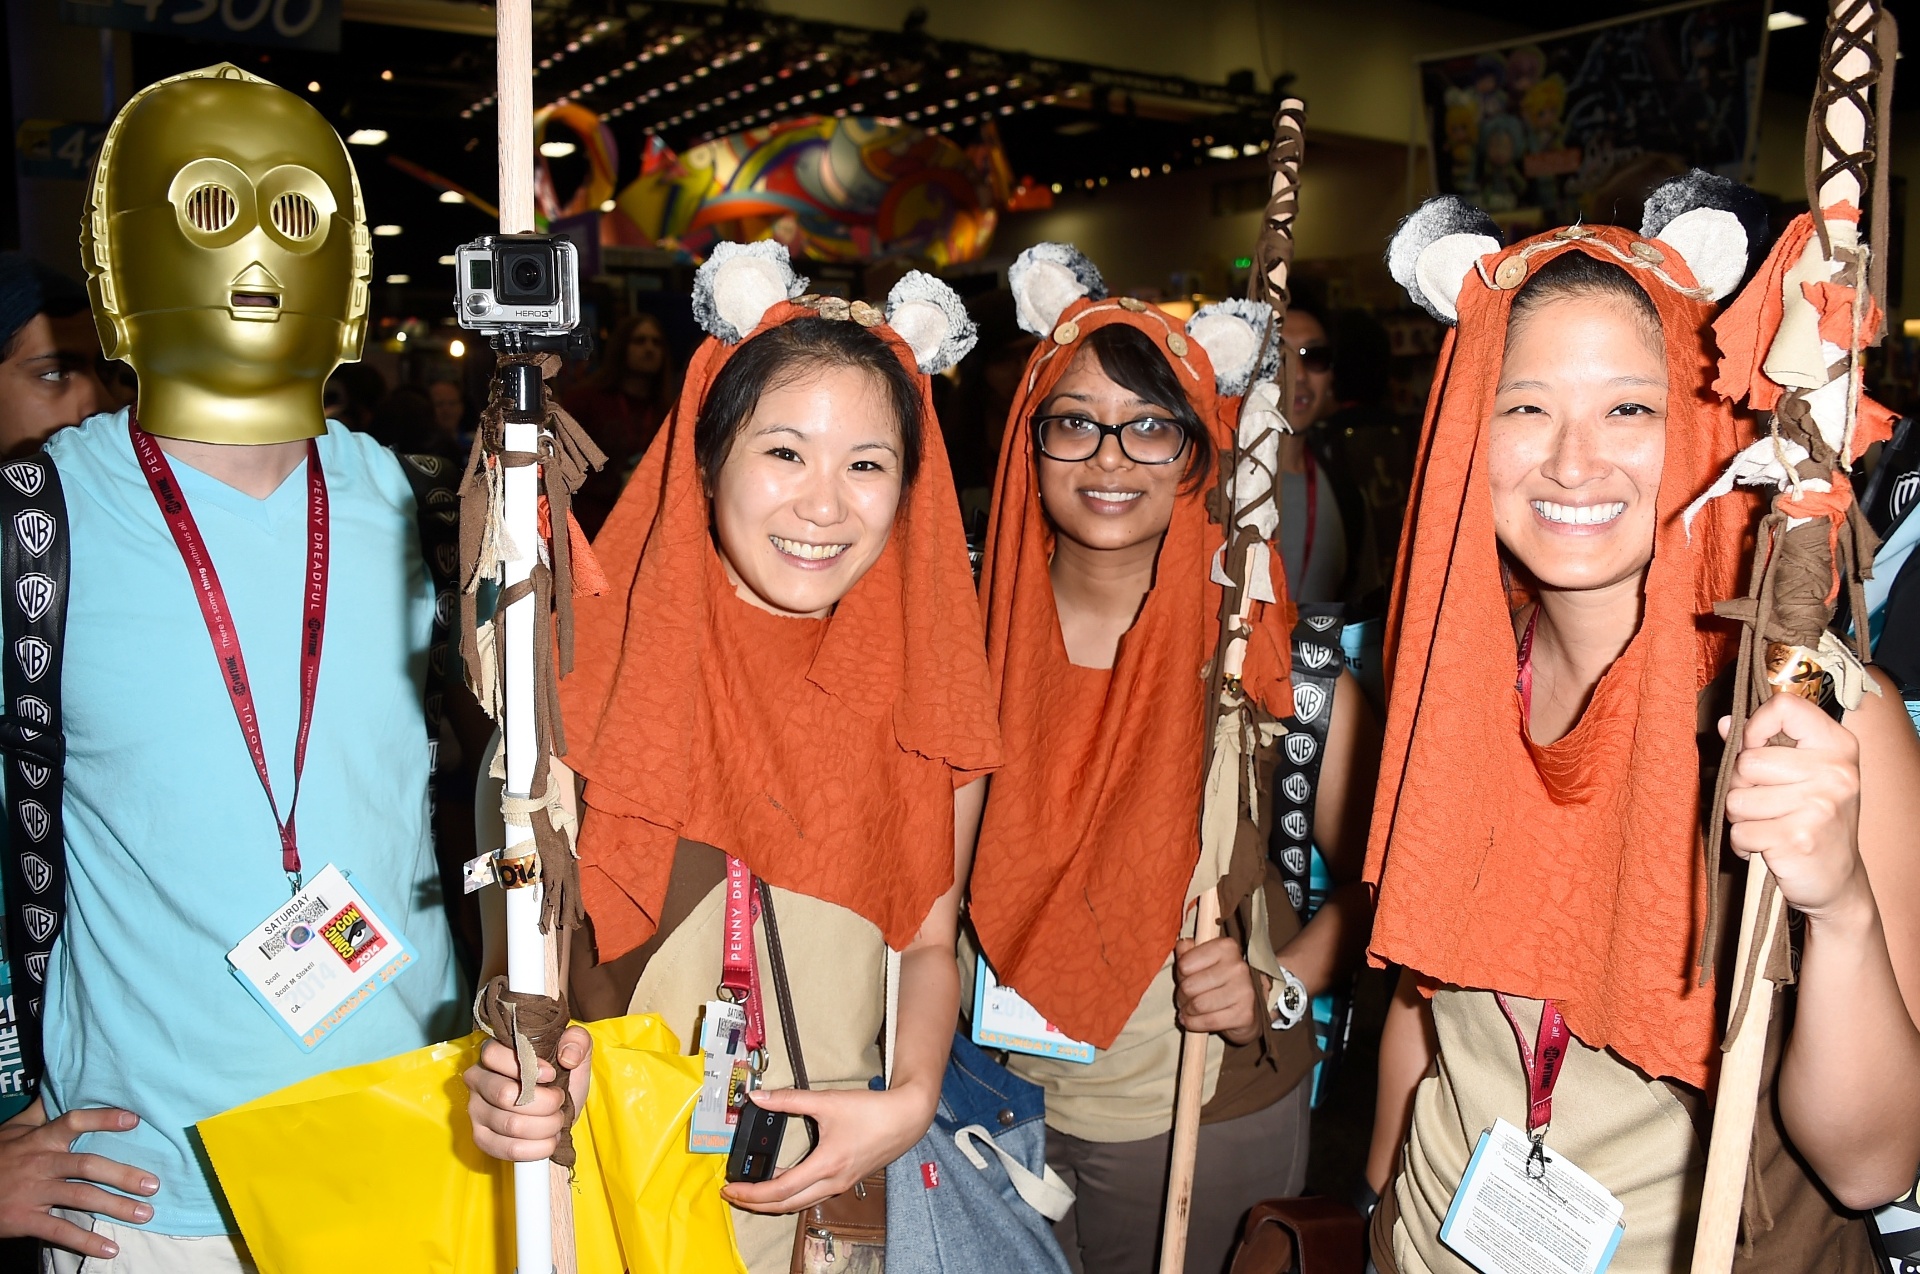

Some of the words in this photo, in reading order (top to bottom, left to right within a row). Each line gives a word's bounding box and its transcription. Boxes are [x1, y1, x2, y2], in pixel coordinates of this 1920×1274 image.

[135, 431, 162, 474] PENNY
[4, 464, 42, 494] WB
[313, 479, 323, 526] PENNY
[18, 512, 53, 555] WB
[183, 531, 192, 541] us
[189, 542, 202, 567] within
[198, 567, 211, 591] thing
[310, 532, 323, 611] DREADFUL
[19, 576, 54, 619] WB
[207, 591, 220, 614] some
[215, 614, 222, 623] is
[218, 623, 231, 648] There
[18, 637, 50, 680] WB
[1294, 685, 1323, 722] WB
[1287, 734, 1315, 763] WB
[21, 801, 49, 840] WB
[23, 854, 51, 891] WB
[25, 906, 55, 941] WB
[264, 894, 310, 935] SATURDAY
[335, 908, 360, 932] CON
[324, 926, 355, 959] COMIC
[730, 908, 743, 961] PENNY
[356, 944, 380, 966] 2014
[264, 972, 281, 986] Scott
[274, 984, 291, 998] Scott
[289, 978, 297, 986] M
[290, 1003, 301, 1014] CA
[303, 980, 378, 1047] SATURDAY
[378, 952, 412, 984] 2014
[979, 1031, 1052, 1052] SATURDAY
[1057, 1045, 1088, 1058] 2014
[1551, 1026, 1560, 1039] all.
[1541, 1045, 1560, 1090] SHOWTIME
[727, 1067, 739, 1107] COMIC
[693, 1134, 730, 1147] SATURDAY
